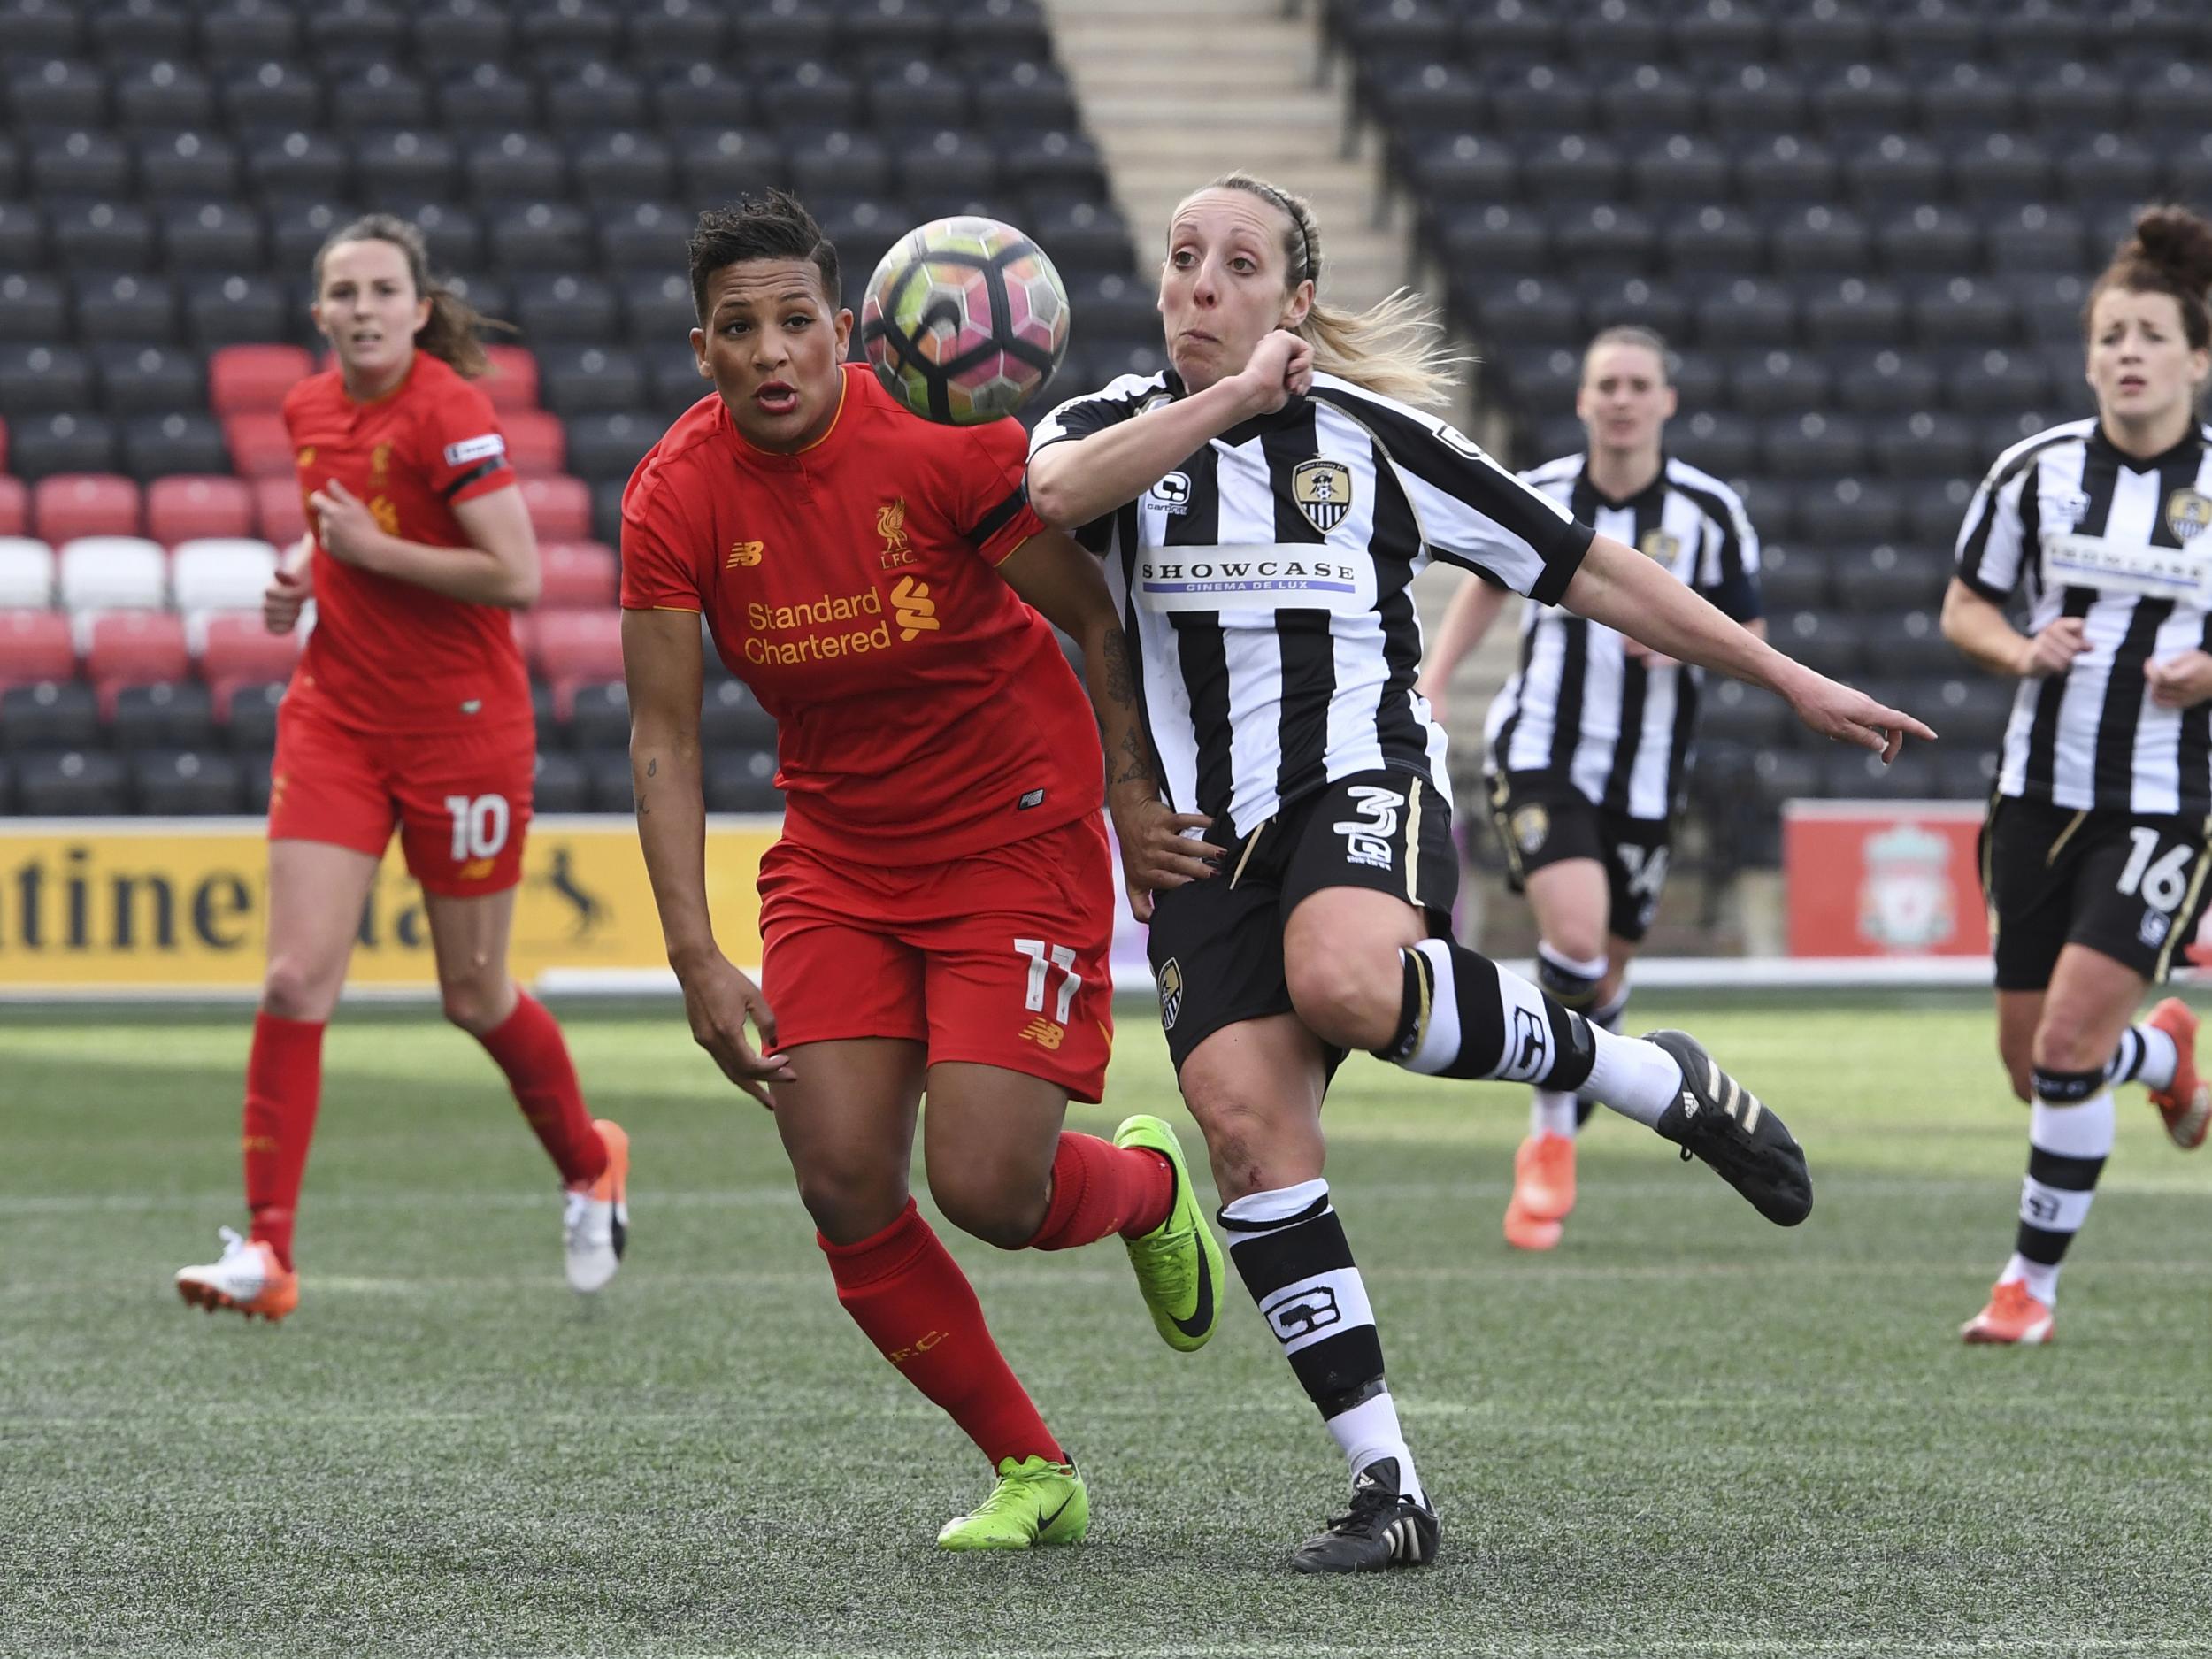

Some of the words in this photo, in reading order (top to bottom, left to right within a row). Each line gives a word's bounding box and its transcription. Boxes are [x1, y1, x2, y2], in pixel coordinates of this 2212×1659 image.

[1142, 561, 1355, 581] SHOWCASE
[1186, 582, 1246, 592] CINEMA
[1278, 581, 1309, 590] LUX
[748, 586, 882, 631] Standard
[744, 620, 891, 665] Chartered
[444, 793, 509, 861] 10
[2116, 825, 2194, 913] 16
[1014, 938, 1082, 1025] 11
